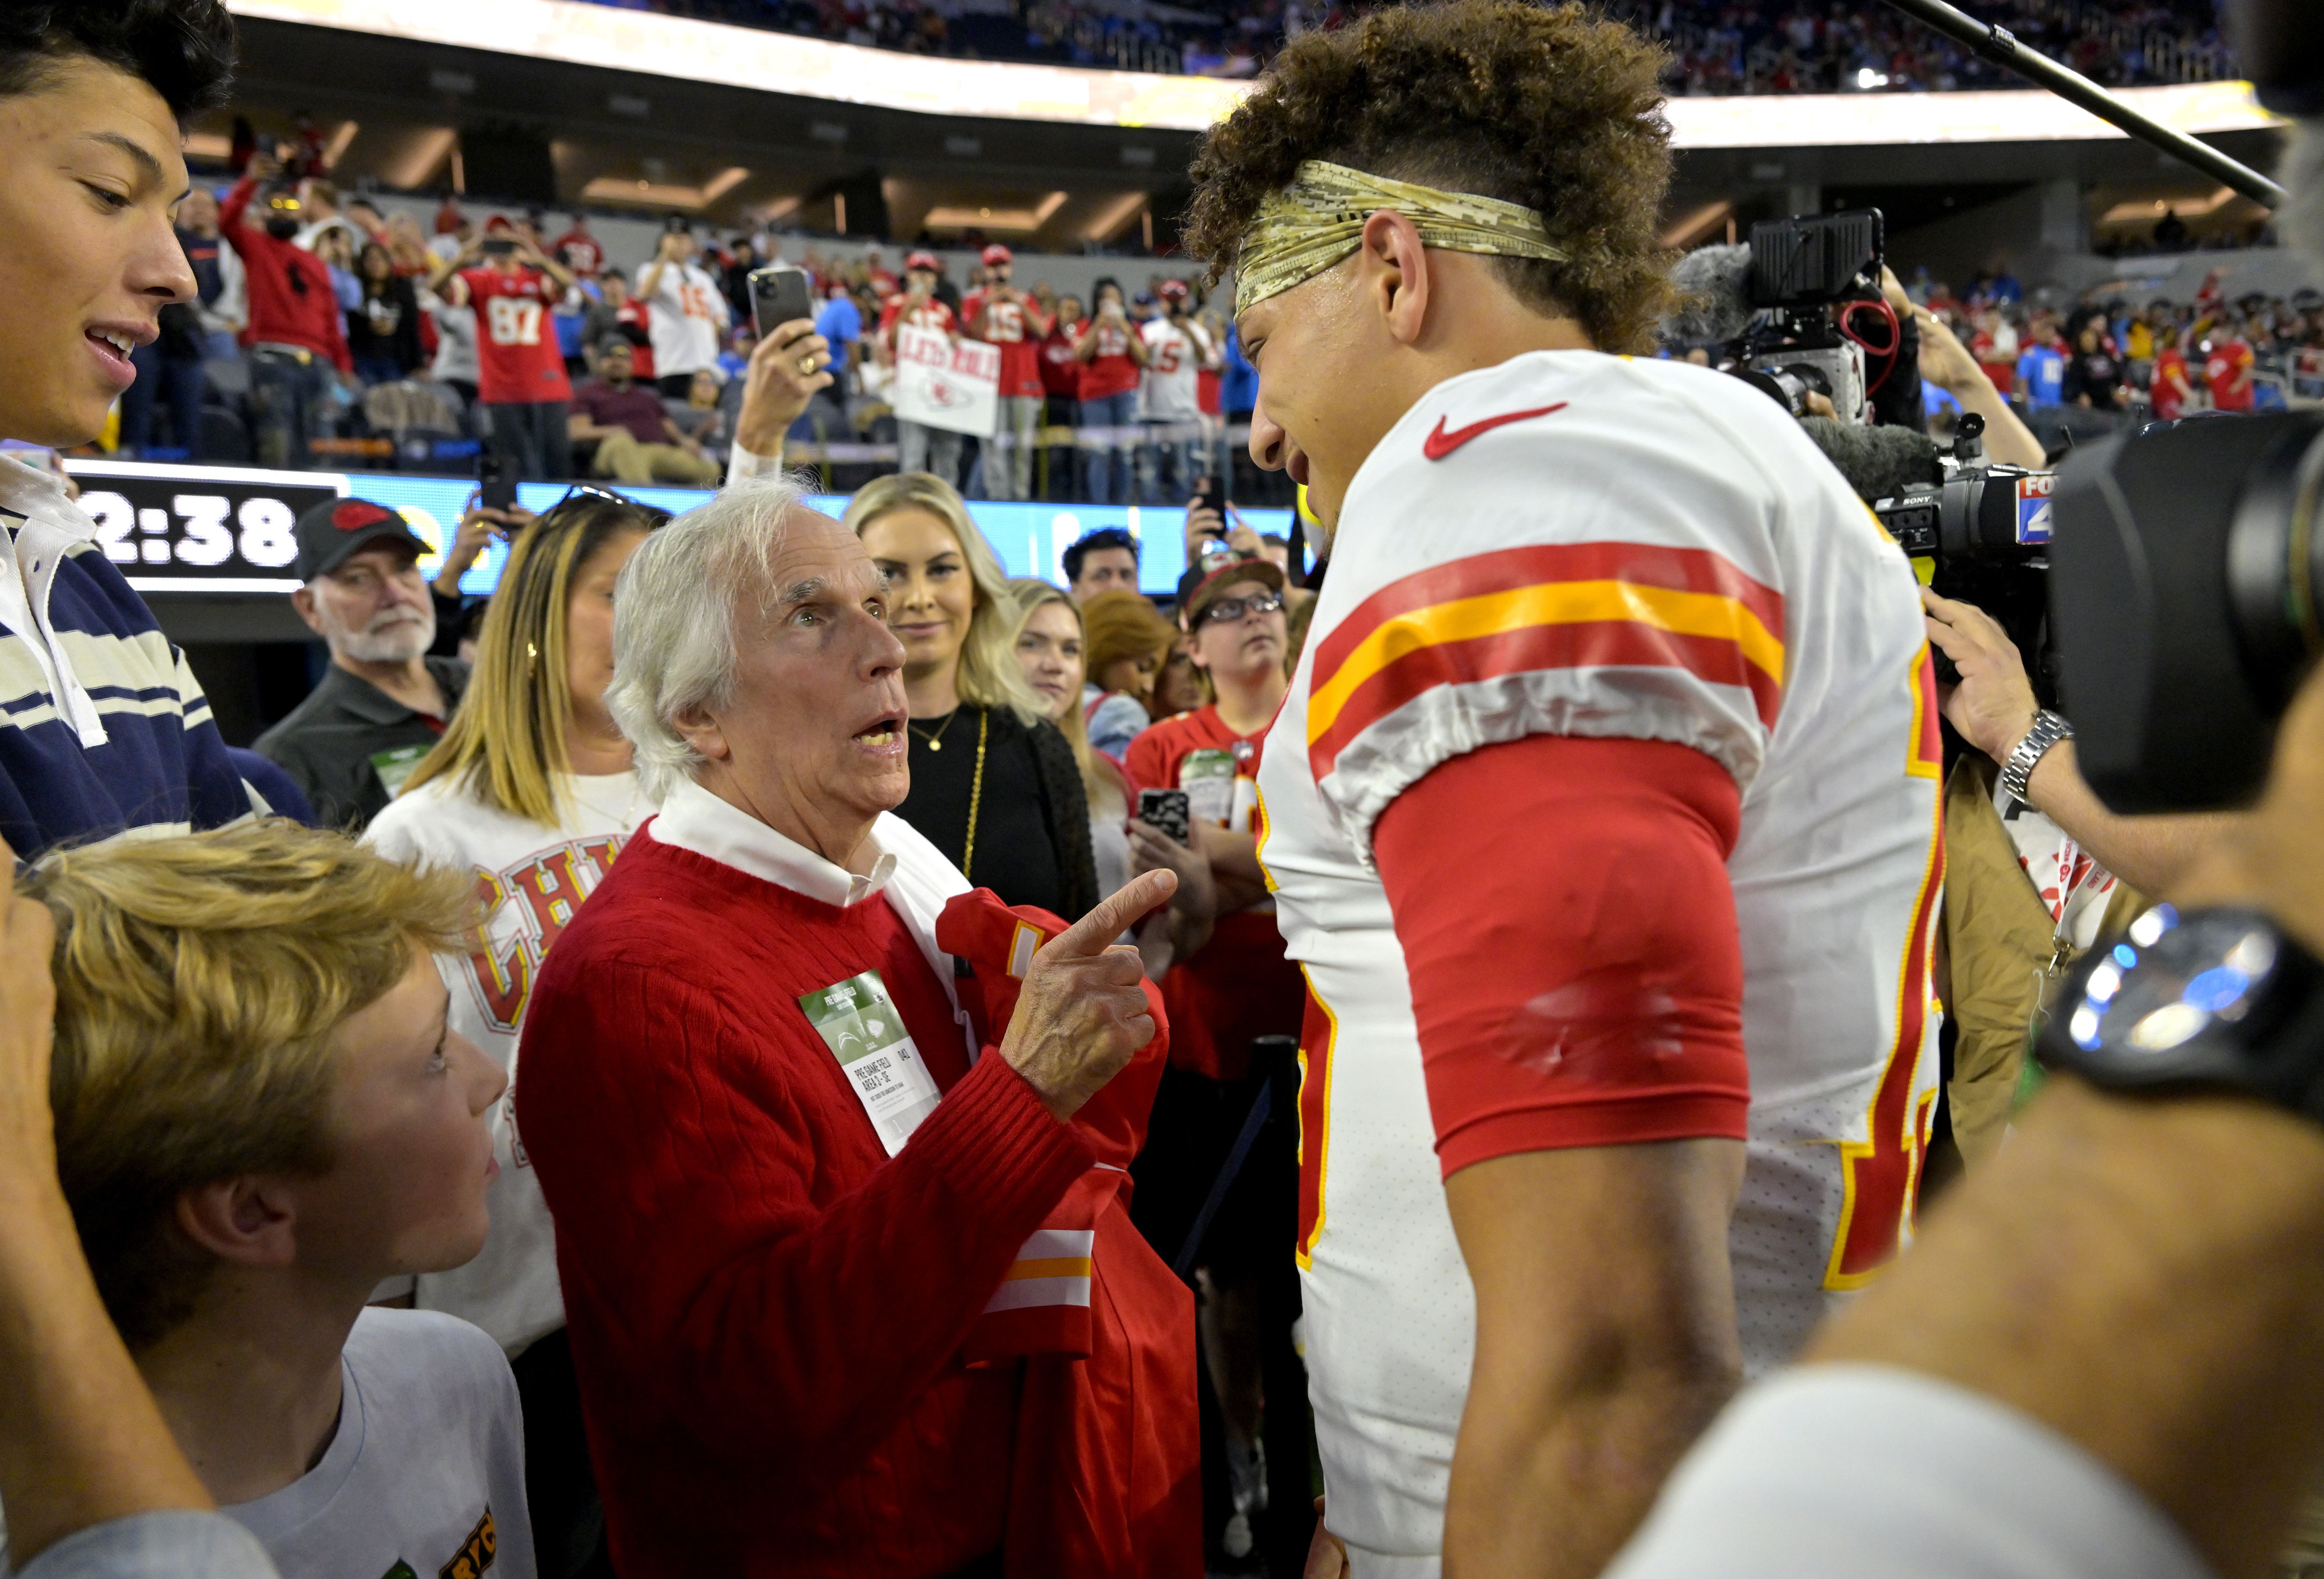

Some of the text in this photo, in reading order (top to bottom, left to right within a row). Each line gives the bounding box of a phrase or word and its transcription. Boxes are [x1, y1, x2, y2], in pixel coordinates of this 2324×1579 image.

[487, 294, 543, 346] 87
[984, 302, 1023, 343] 15
[2026, 476, 2056, 496] FO
[1903, 495, 1931, 506] SONY
[76, 491, 299, 567] 2:38
[2027, 502, 2055, 536] 4
[854, 1057, 891, 1080] PRE GAME FIELD
[862, 1077, 878, 1092] AREA
[874, 1075, 882, 1086] 3
[881, 1071, 891, 1082] SE
